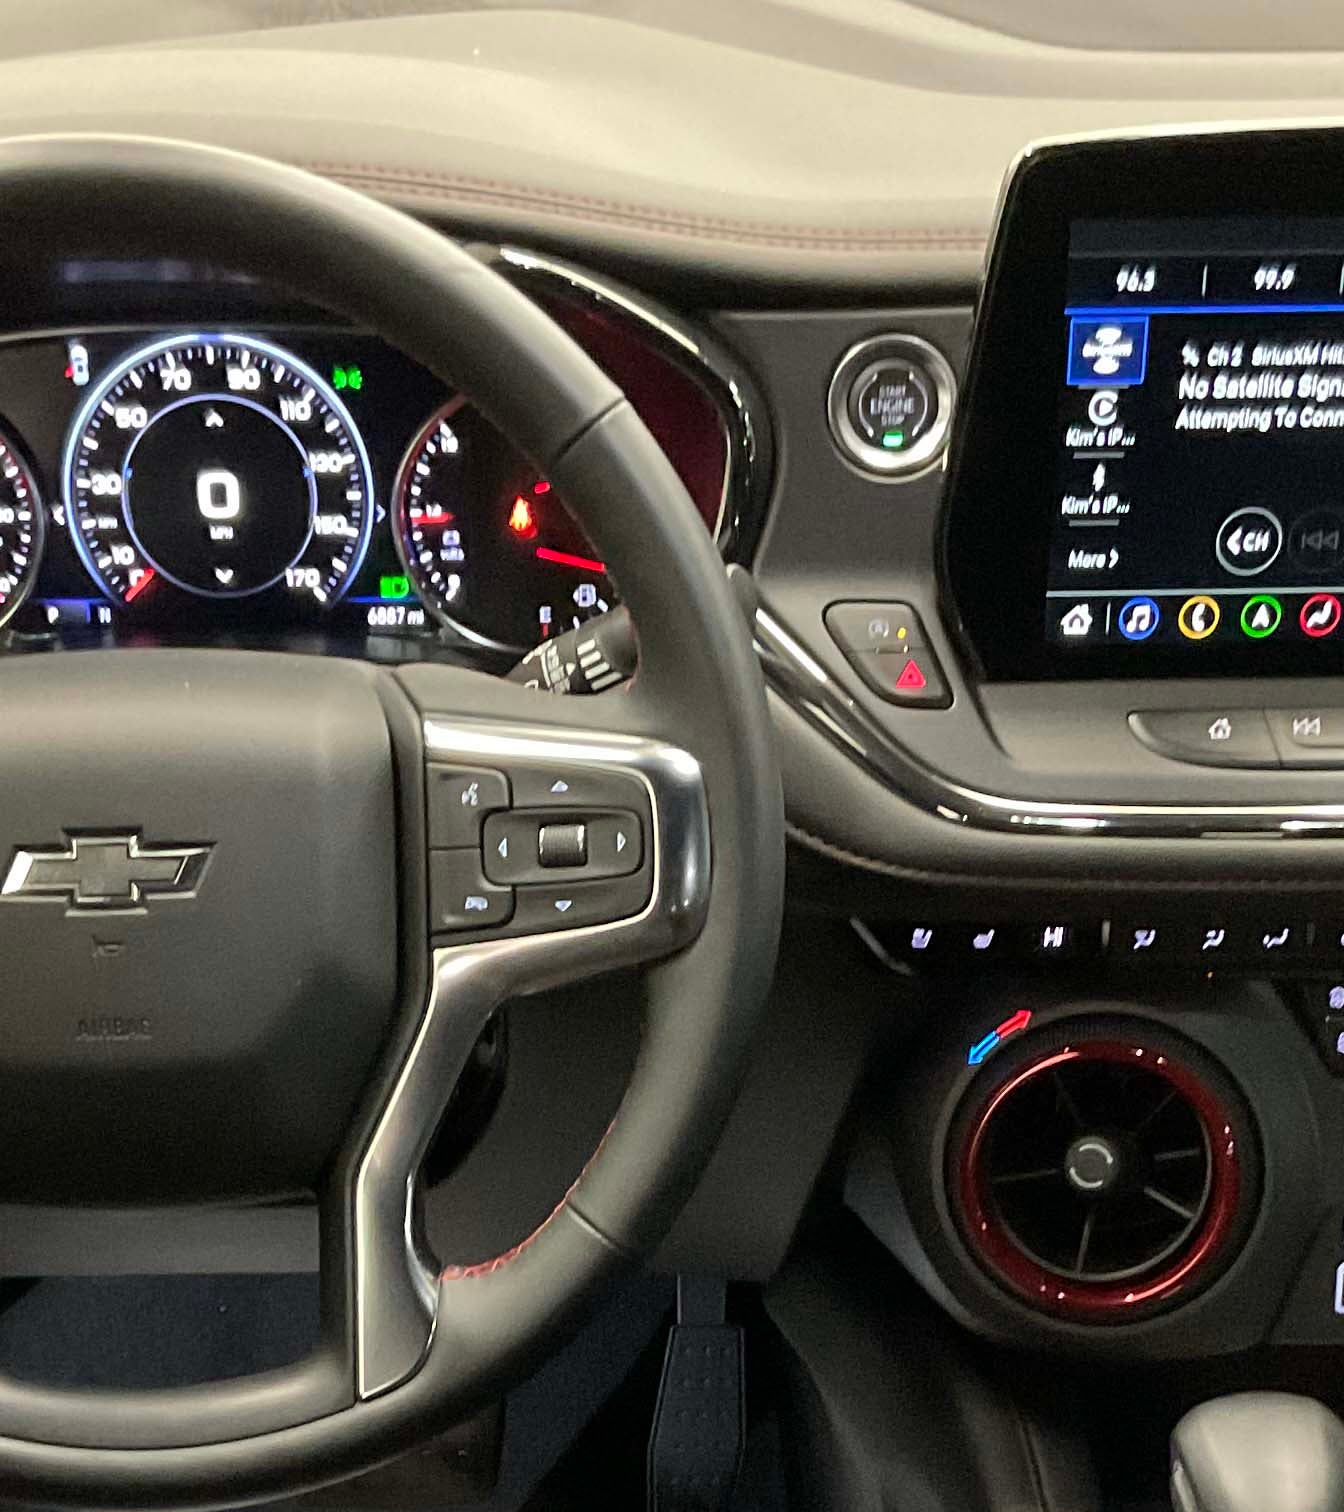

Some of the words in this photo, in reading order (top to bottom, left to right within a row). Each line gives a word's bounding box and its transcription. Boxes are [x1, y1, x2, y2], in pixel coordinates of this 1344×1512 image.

[1254, 266, 1296, 290] 99.9
[1207, 343, 1230, 367] Ch
[1230, 343, 1243, 367] 2
[1251, 344, 1320, 366] SiriusXM
[160, 368, 192, 391] 70
[1179, 374, 1208, 399] No
[1212, 373, 1295, 399] Satellite
[280, 399, 311, 421] 110
[870, 398, 914, 415] ENGINE
[1176, 405, 1271, 432] Attempting
[1274, 405, 1297, 428] To
[1066, 427, 1105, 447] Kim's
[91, 474, 121, 495] 30
[196, 469, 240, 519] 0
[1061, 495, 1100, 514] Kim's
[1243, 529, 1271, 552] CH
[111, 545, 134, 565] 10
[1068, 549, 1106, 569] More
[285, 568, 320, 588] 170
[407, 608, 424, 625] mi
[1043, 926, 1064, 948] HI
